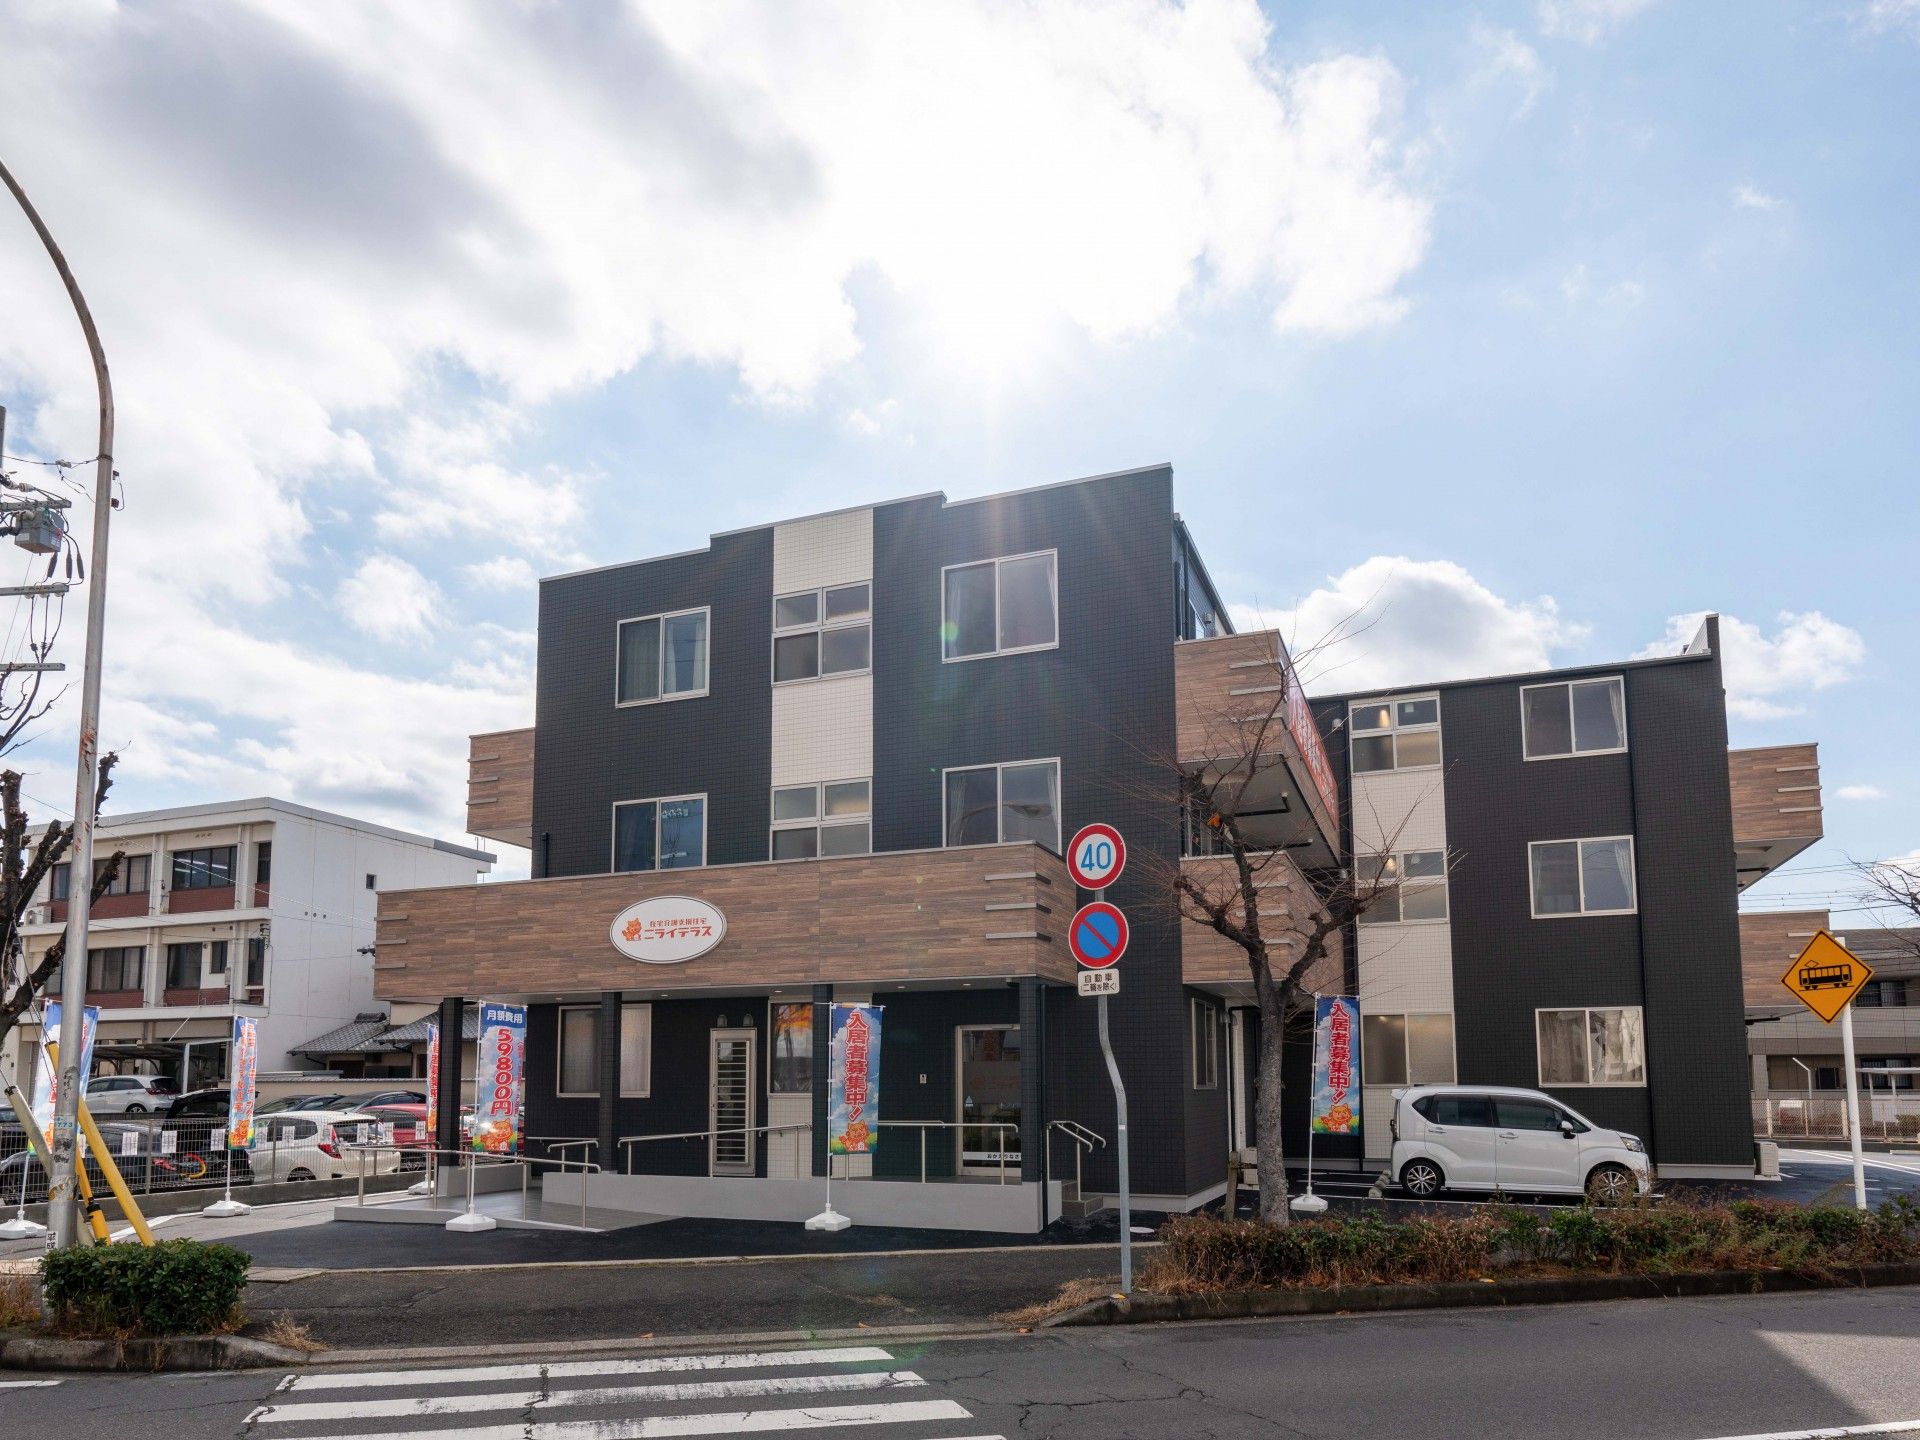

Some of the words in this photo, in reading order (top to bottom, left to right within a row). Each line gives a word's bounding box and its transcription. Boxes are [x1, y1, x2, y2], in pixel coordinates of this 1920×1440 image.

[1081, 842, 1112, 872] 40
[645, 926, 712, 939] ニライテラス
[1084, 972, 1113, 983] 自動車
[486, 1010, 523, 1024] 月額費用
[490, 1028, 513, 1117] 59800円
